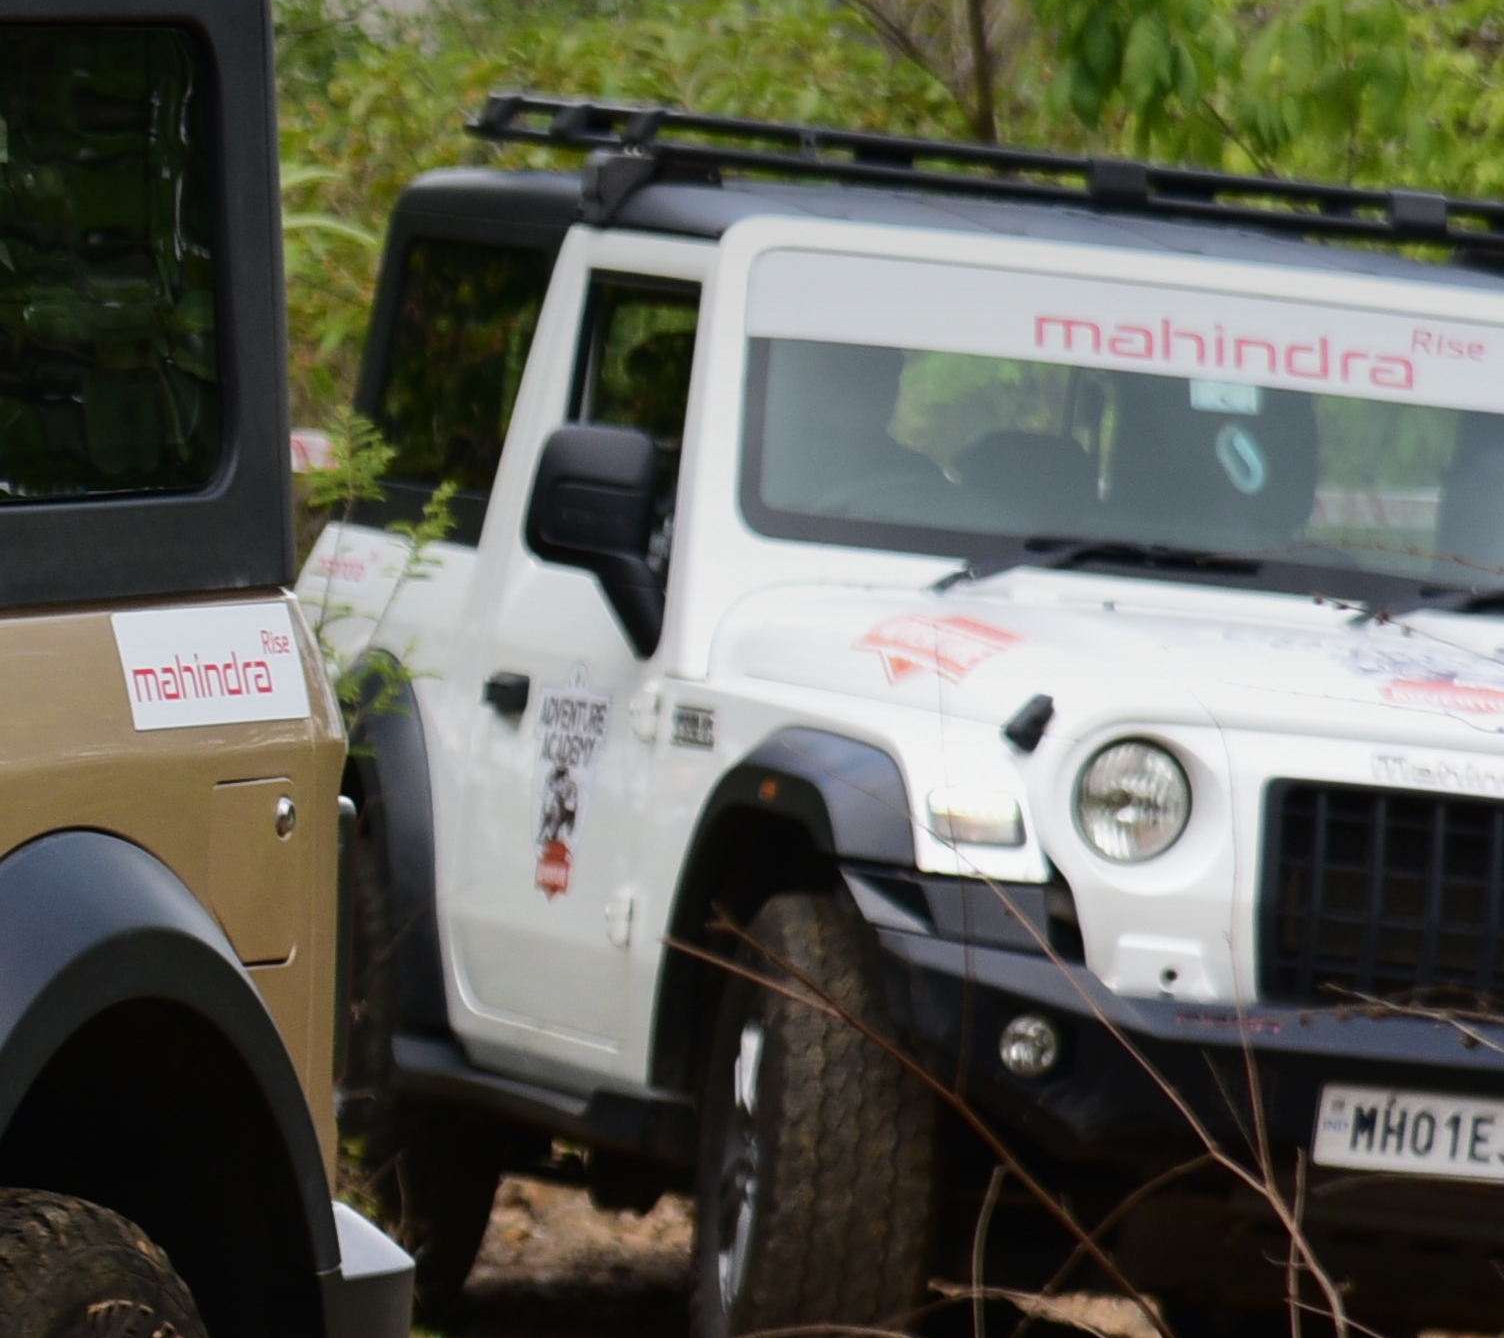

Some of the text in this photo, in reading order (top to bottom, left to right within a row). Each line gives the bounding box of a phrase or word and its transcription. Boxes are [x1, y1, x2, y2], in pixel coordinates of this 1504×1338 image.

[1033, 313, 1487, 391] mahindra Rise
[131, 629, 291, 703] mahindra Rise
[1349, 1103, 1504, 1165] MH01E
